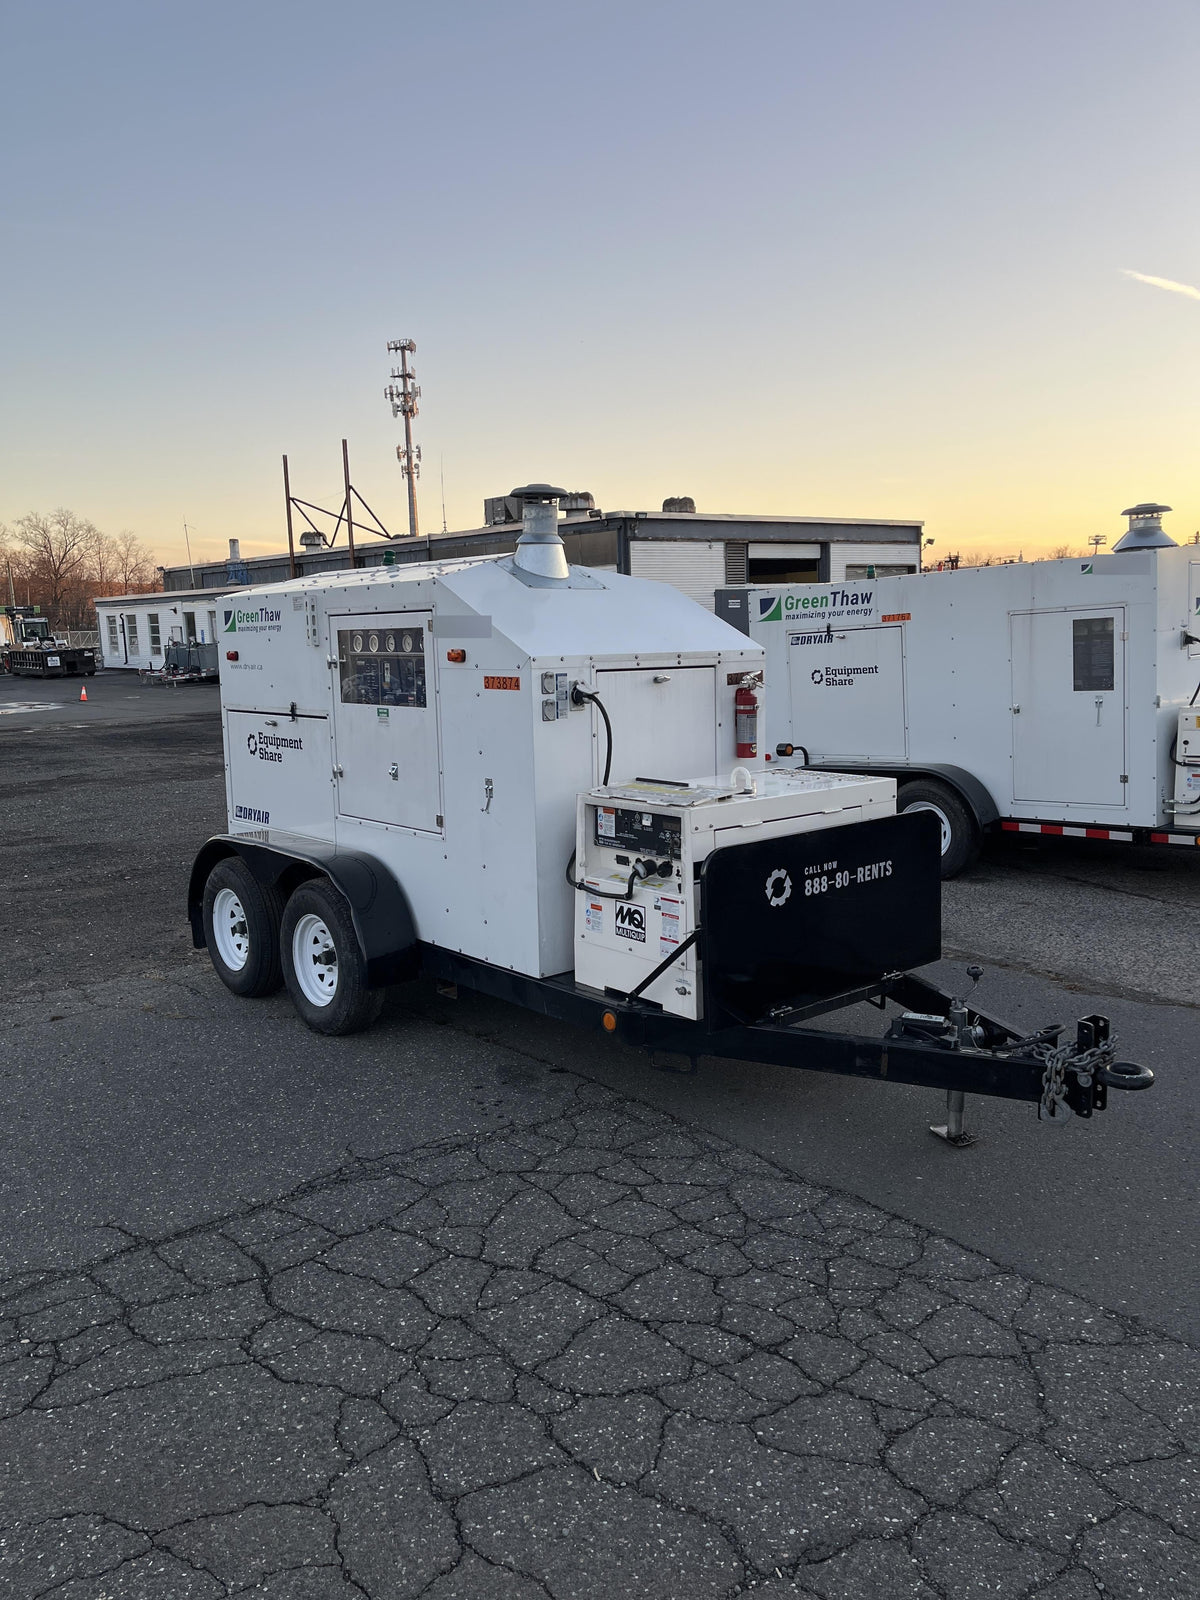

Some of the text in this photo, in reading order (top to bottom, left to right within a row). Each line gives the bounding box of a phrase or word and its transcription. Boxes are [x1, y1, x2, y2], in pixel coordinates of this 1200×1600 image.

[785, 607, 873, 621] maximizing your energy
[238, 625, 258, 633] maximizing
[268, 624, 281, 632] energy
[800, 633, 834, 645] DRYAIR
[825, 665, 879, 677] Equipment
[484, 676, 520, 690] 373874
[825, 677, 854, 687] Share
[258, 732, 303, 750] Equipment
[259, 747, 282, 762] Share
[243, 806, 270, 824] DRYAIR
[804, 860, 838, 876] CALL NOW
[804, 860, 893, 896] 888-80-RENTS
[616, 905, 646, 931] MQ
[616, 928, 646, 942] MULTIQUIP
